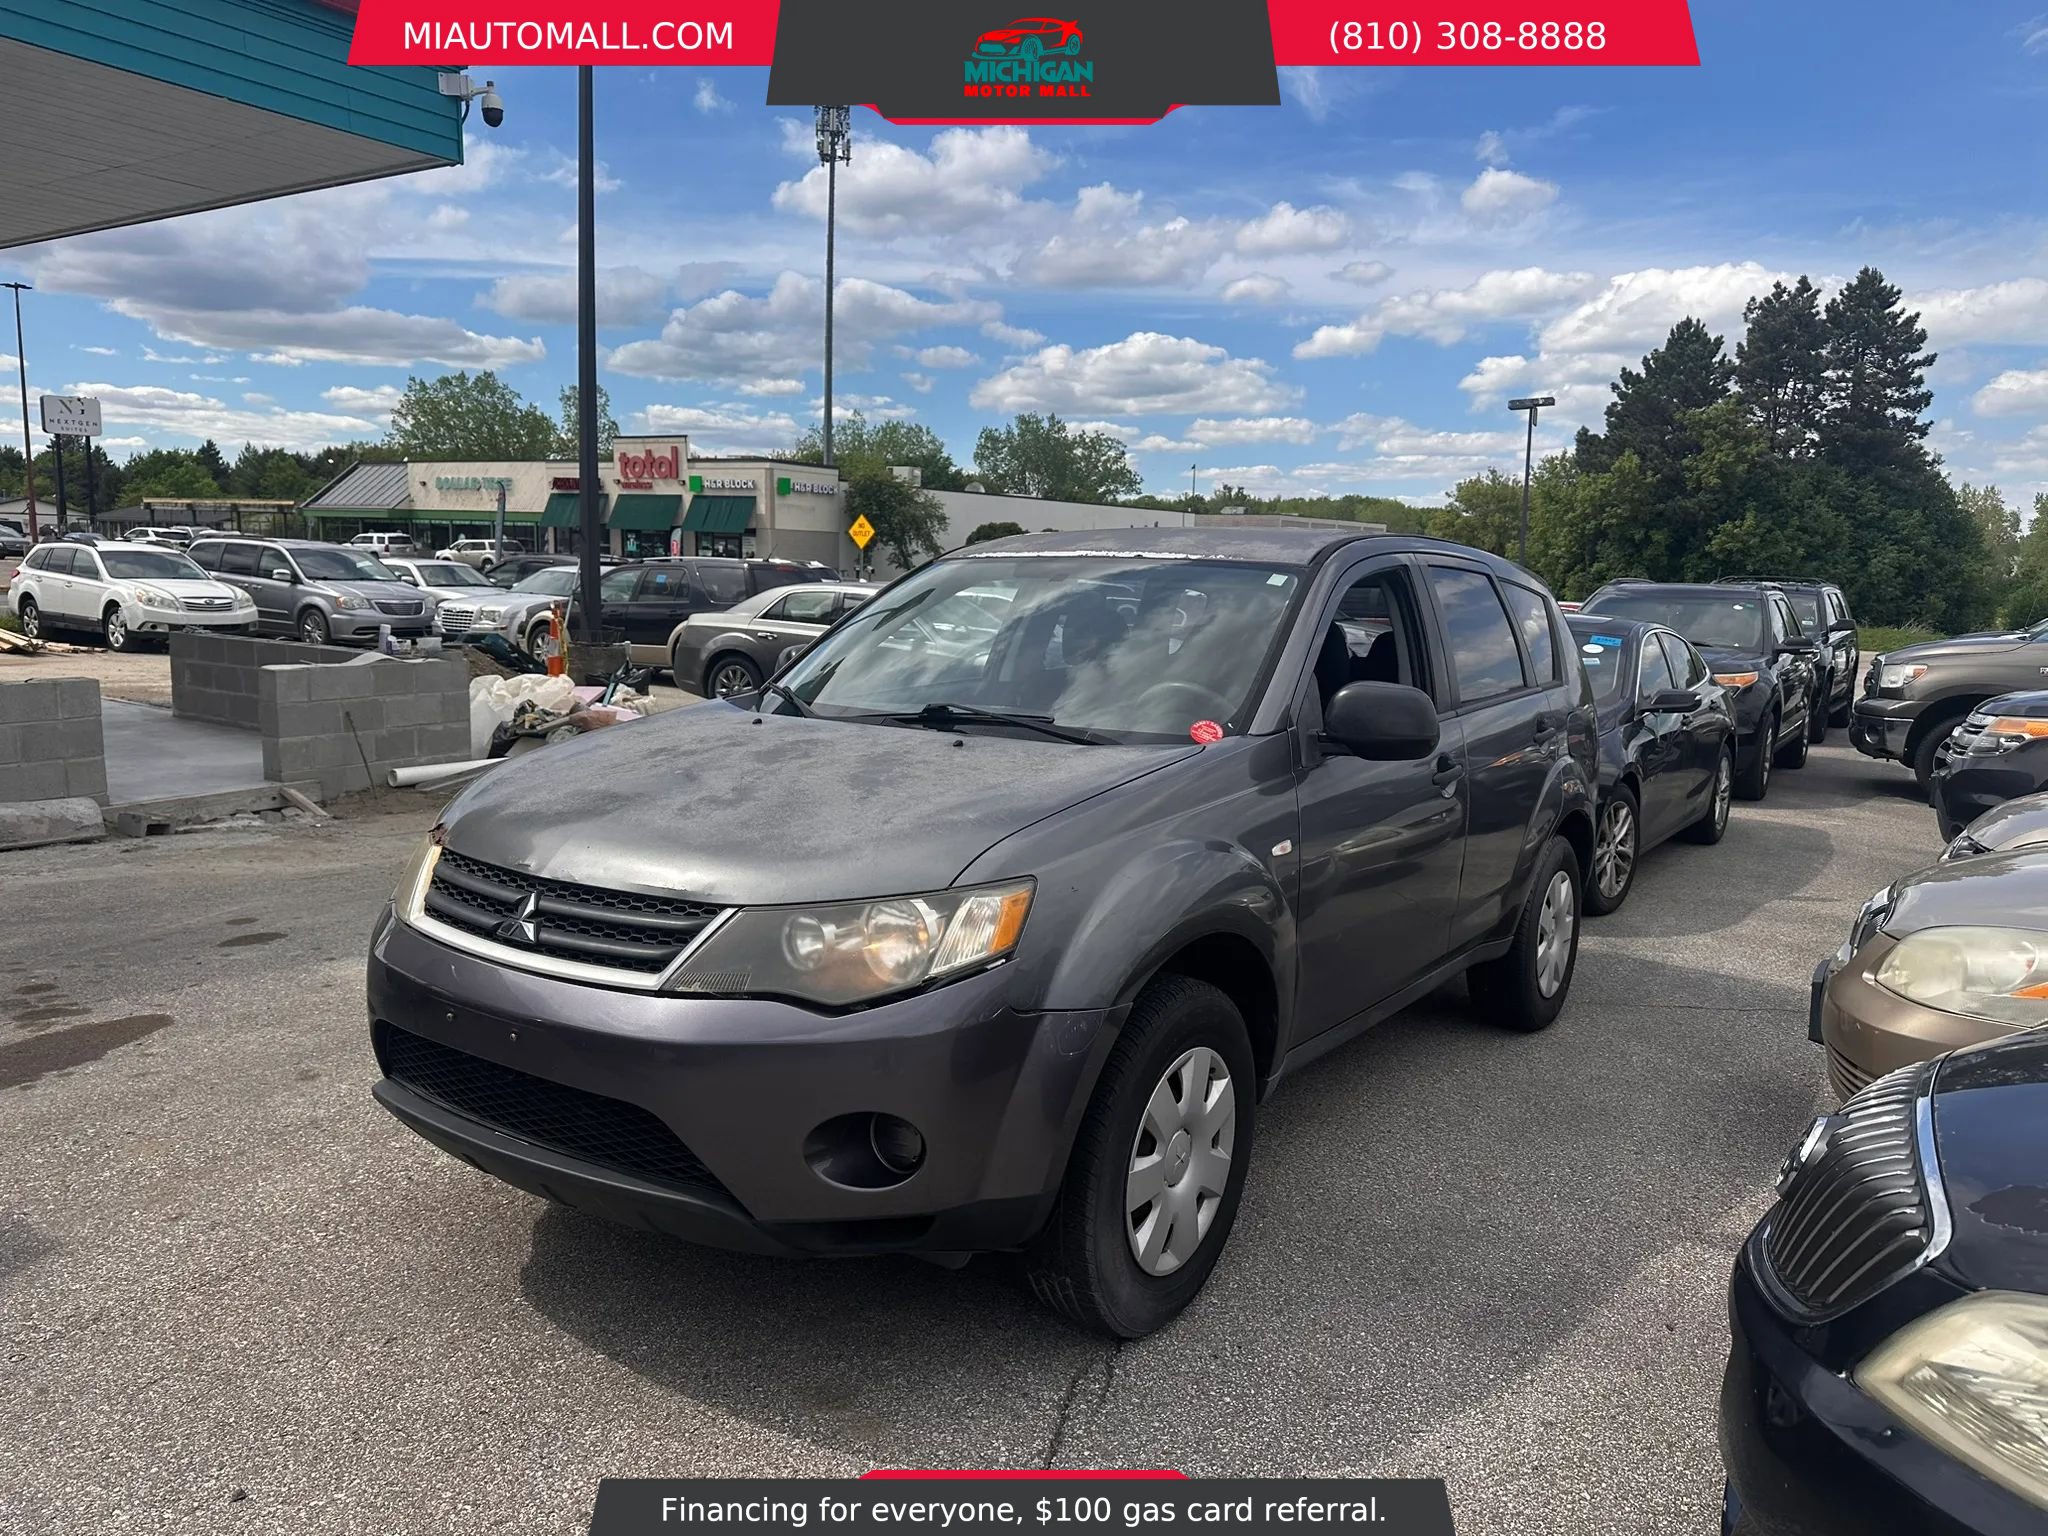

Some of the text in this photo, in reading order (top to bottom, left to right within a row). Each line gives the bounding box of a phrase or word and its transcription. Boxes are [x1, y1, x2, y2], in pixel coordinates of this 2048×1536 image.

[49, 417, 98, 427] NEXTGEN
[618, 446, 679, 479] total
[704, 479, 755, 489] H&R BLOCK
[793, 482, 838, 495] H&R BLOCK
